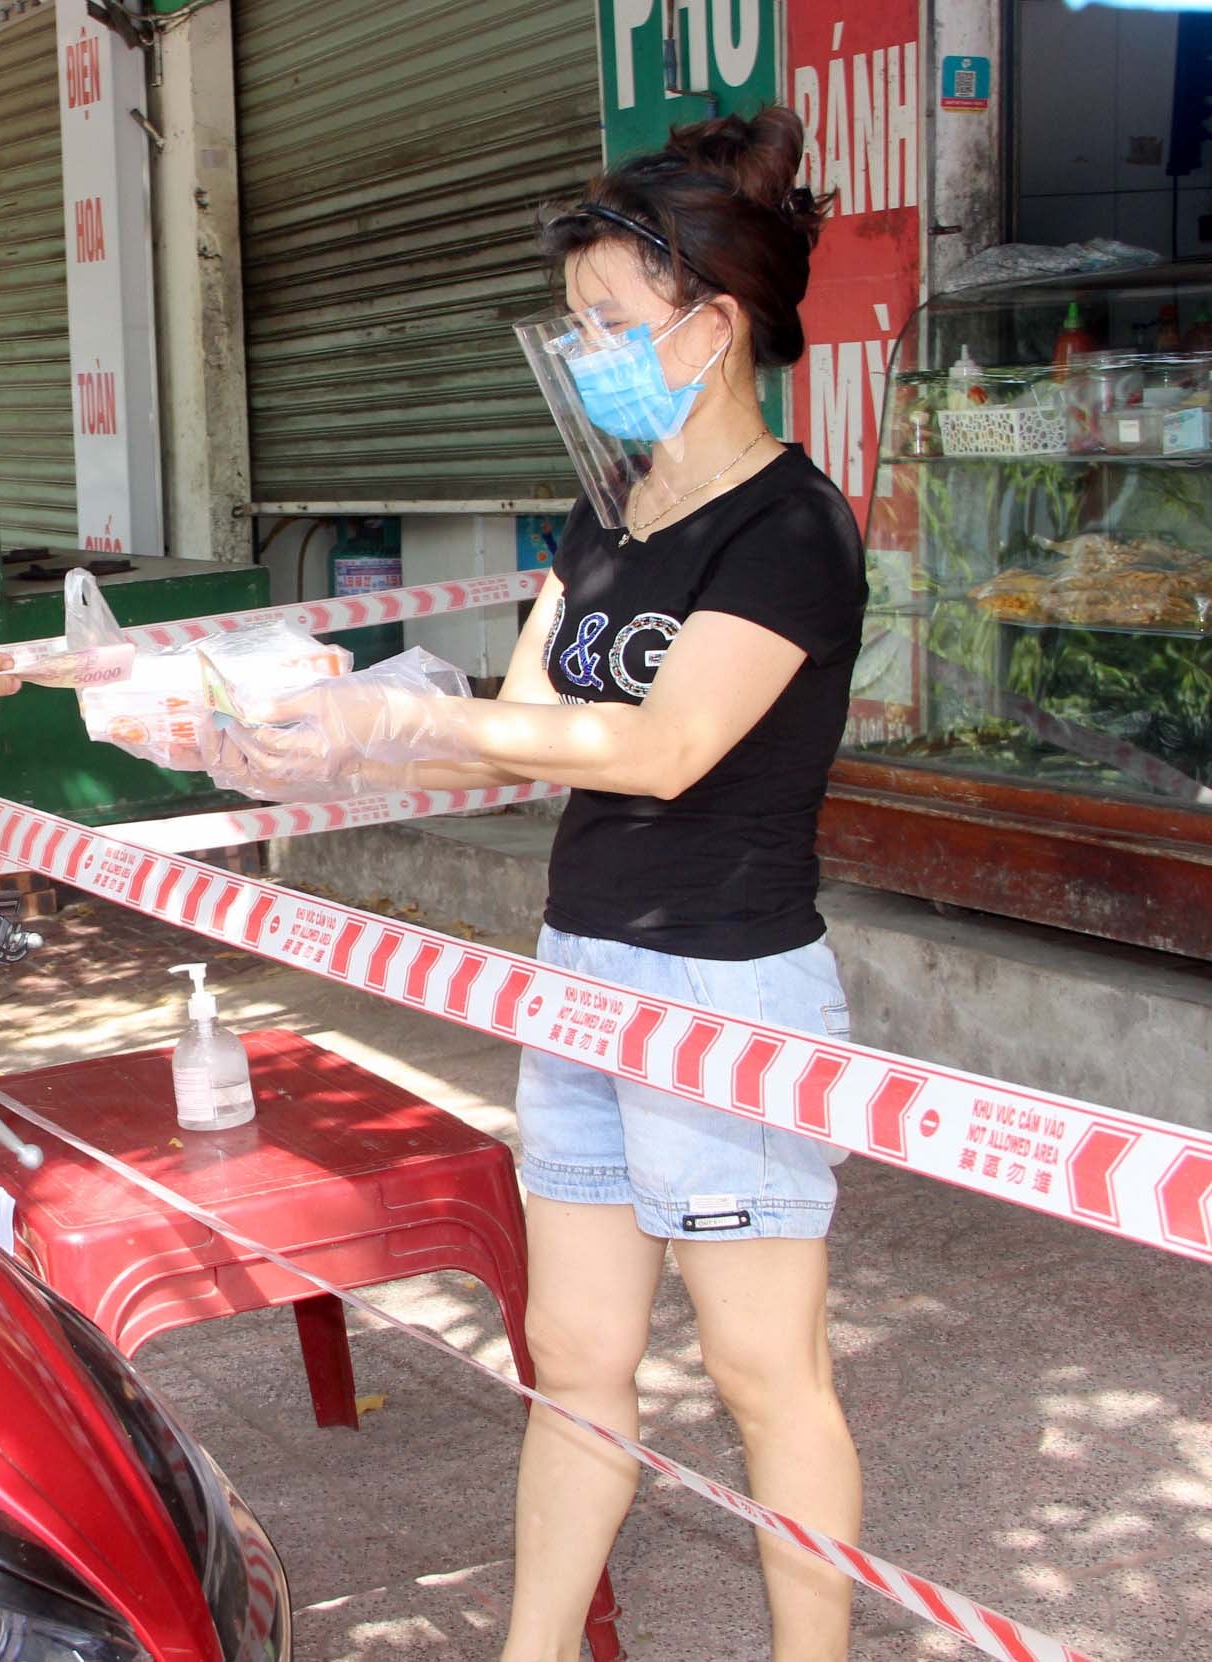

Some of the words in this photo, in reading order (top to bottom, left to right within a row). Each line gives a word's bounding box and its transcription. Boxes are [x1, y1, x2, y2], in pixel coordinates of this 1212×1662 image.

[66, 26, 101, 120] ĐIỆN
[795, 21, 917, 218] BÁNH
[75, 197, 105, 264] HOA
[77, 358, 116, 435] TOÀN
[557, 1007, 573, 1019] NOT
[570, 1010, 601, 1029] ALLOWED
[599, 1018, 618, 1035] AREA
[565, 986, 578, 1002] KHU
[972, 1098, 994, 1121] KHU
[967, 1123, 987, 1144] NOT
[988, 1127, 1031, 1158] ALLOWED
[1032, 1142, 1059, 1166] AREA
